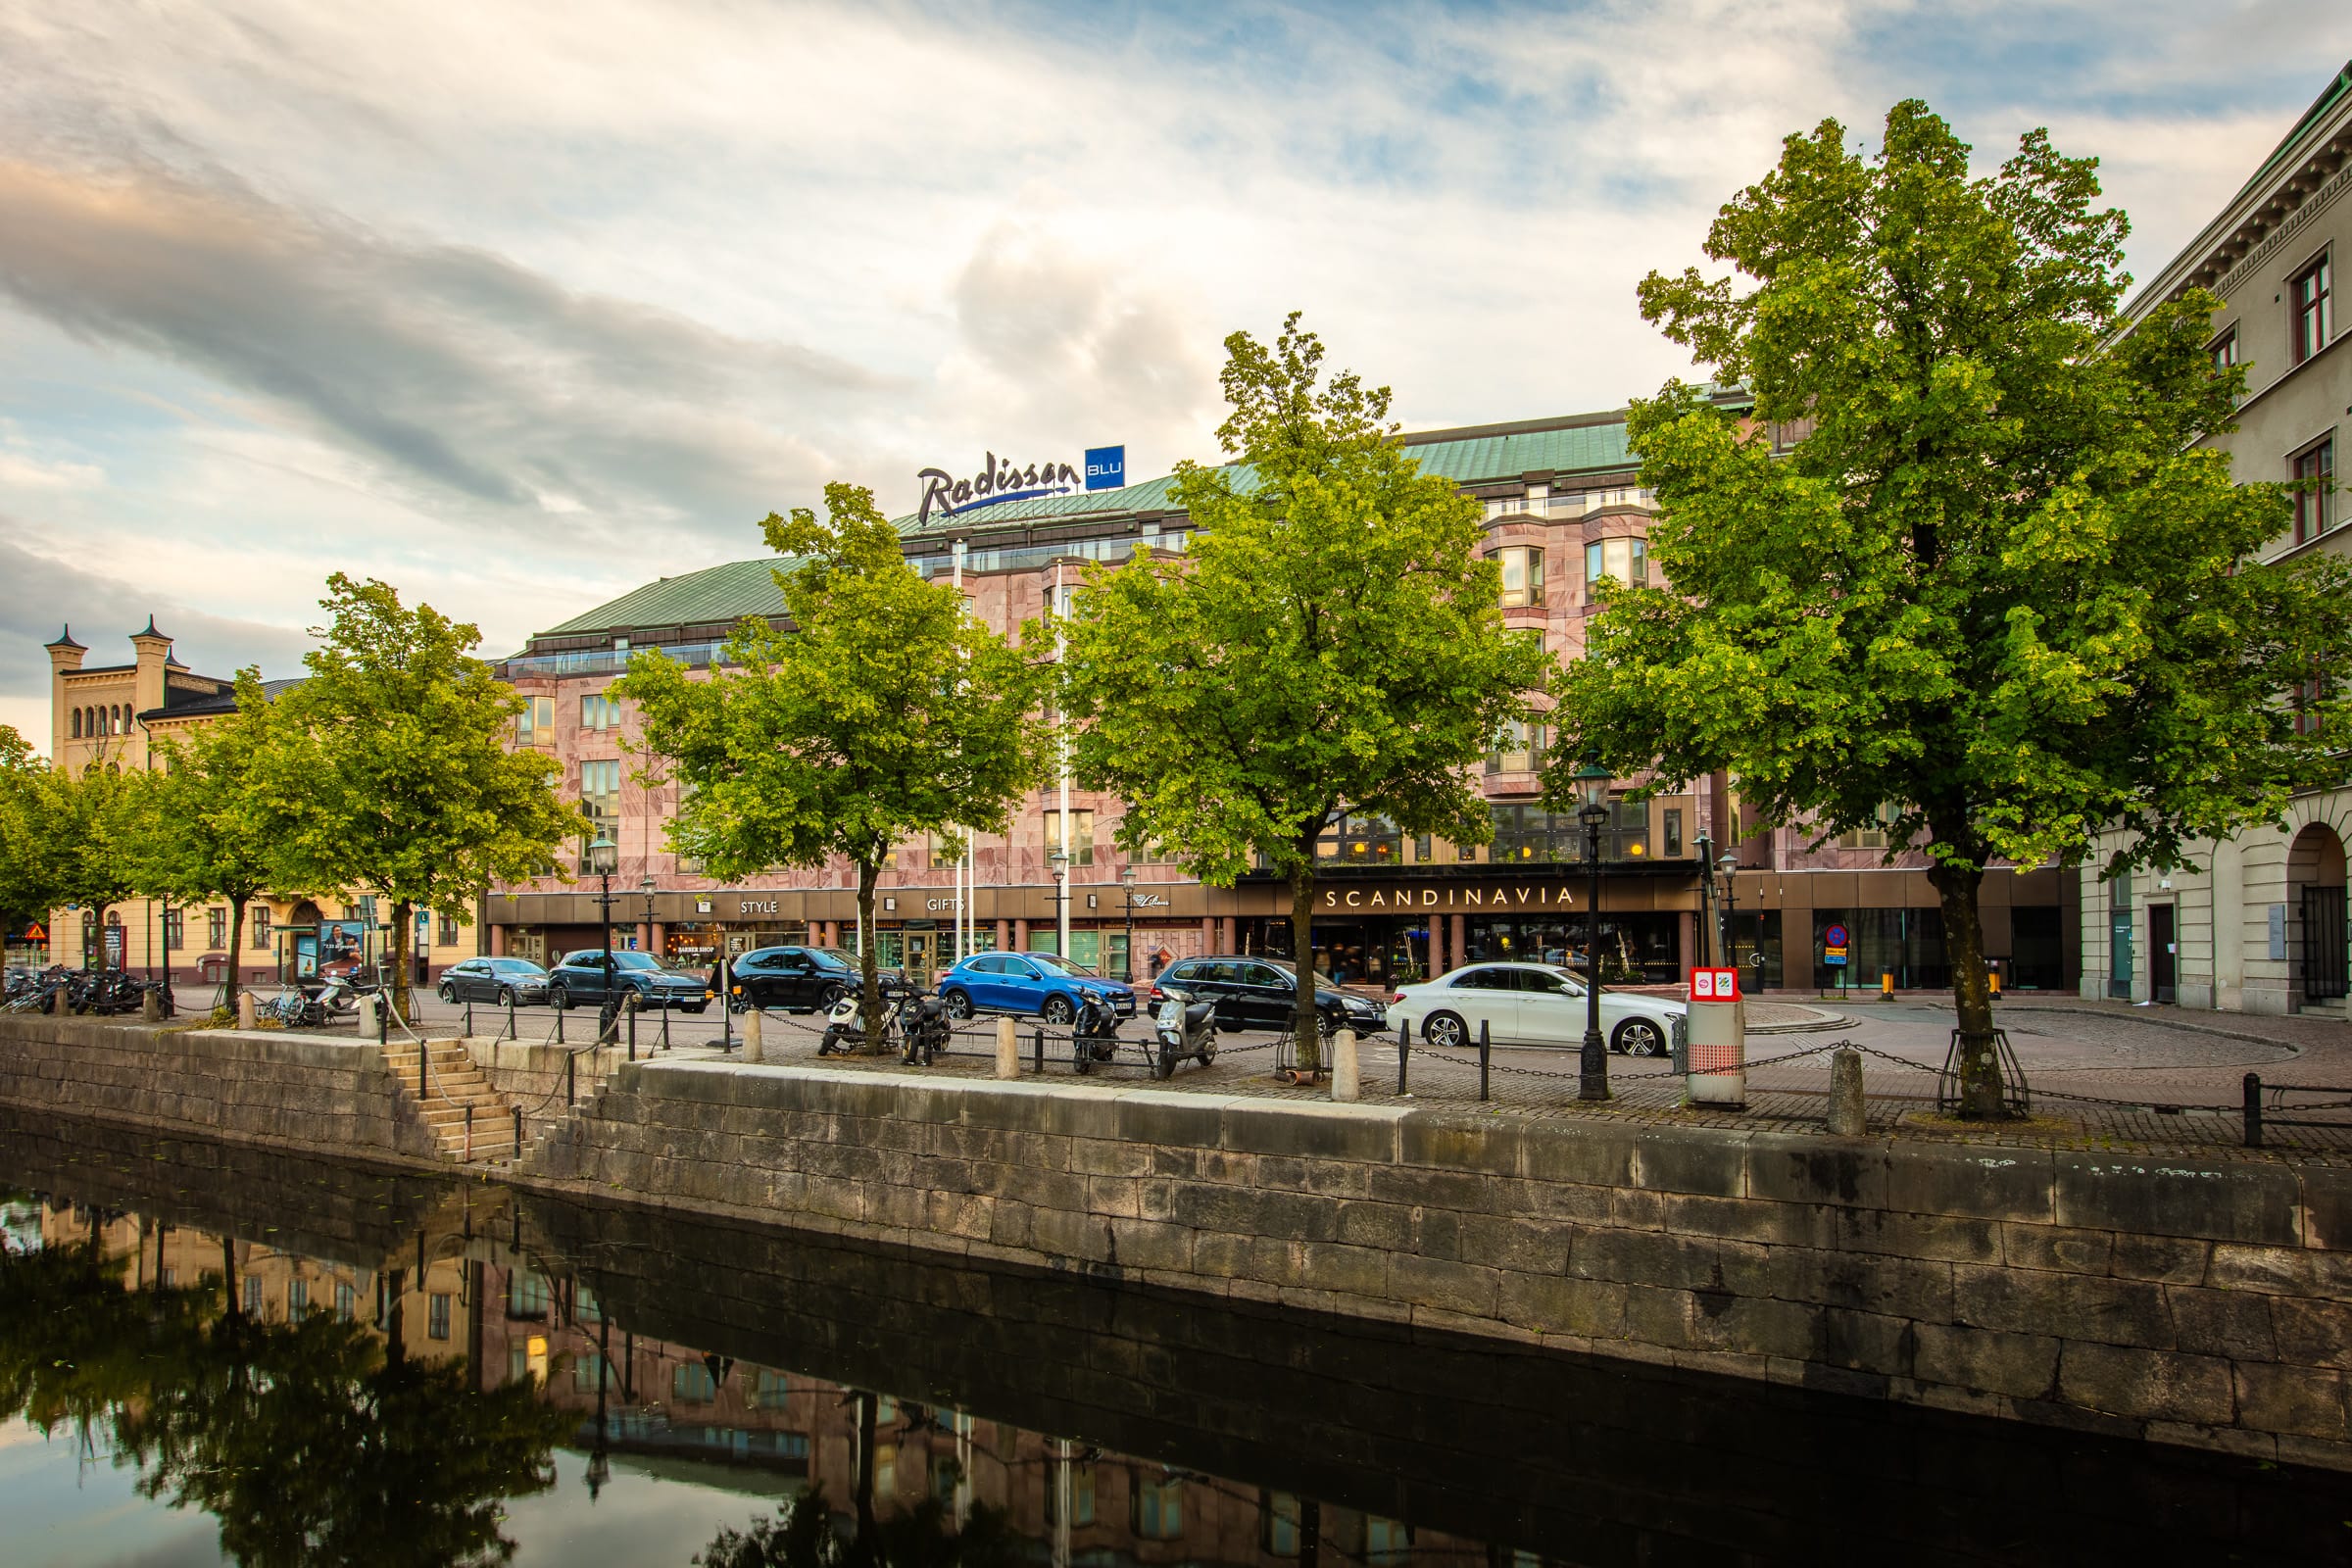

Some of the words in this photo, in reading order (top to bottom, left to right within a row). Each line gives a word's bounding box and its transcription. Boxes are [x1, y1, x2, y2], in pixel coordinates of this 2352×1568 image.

[1087, 462, 1122, 476] BLU
[917, 451, 1081, 526] Radisson
[1326, 887, 1573, 906] SCANDINAVIA
[741, 902, 778, 913] STYLE
[927, 899, 965, 910] GIFTS
